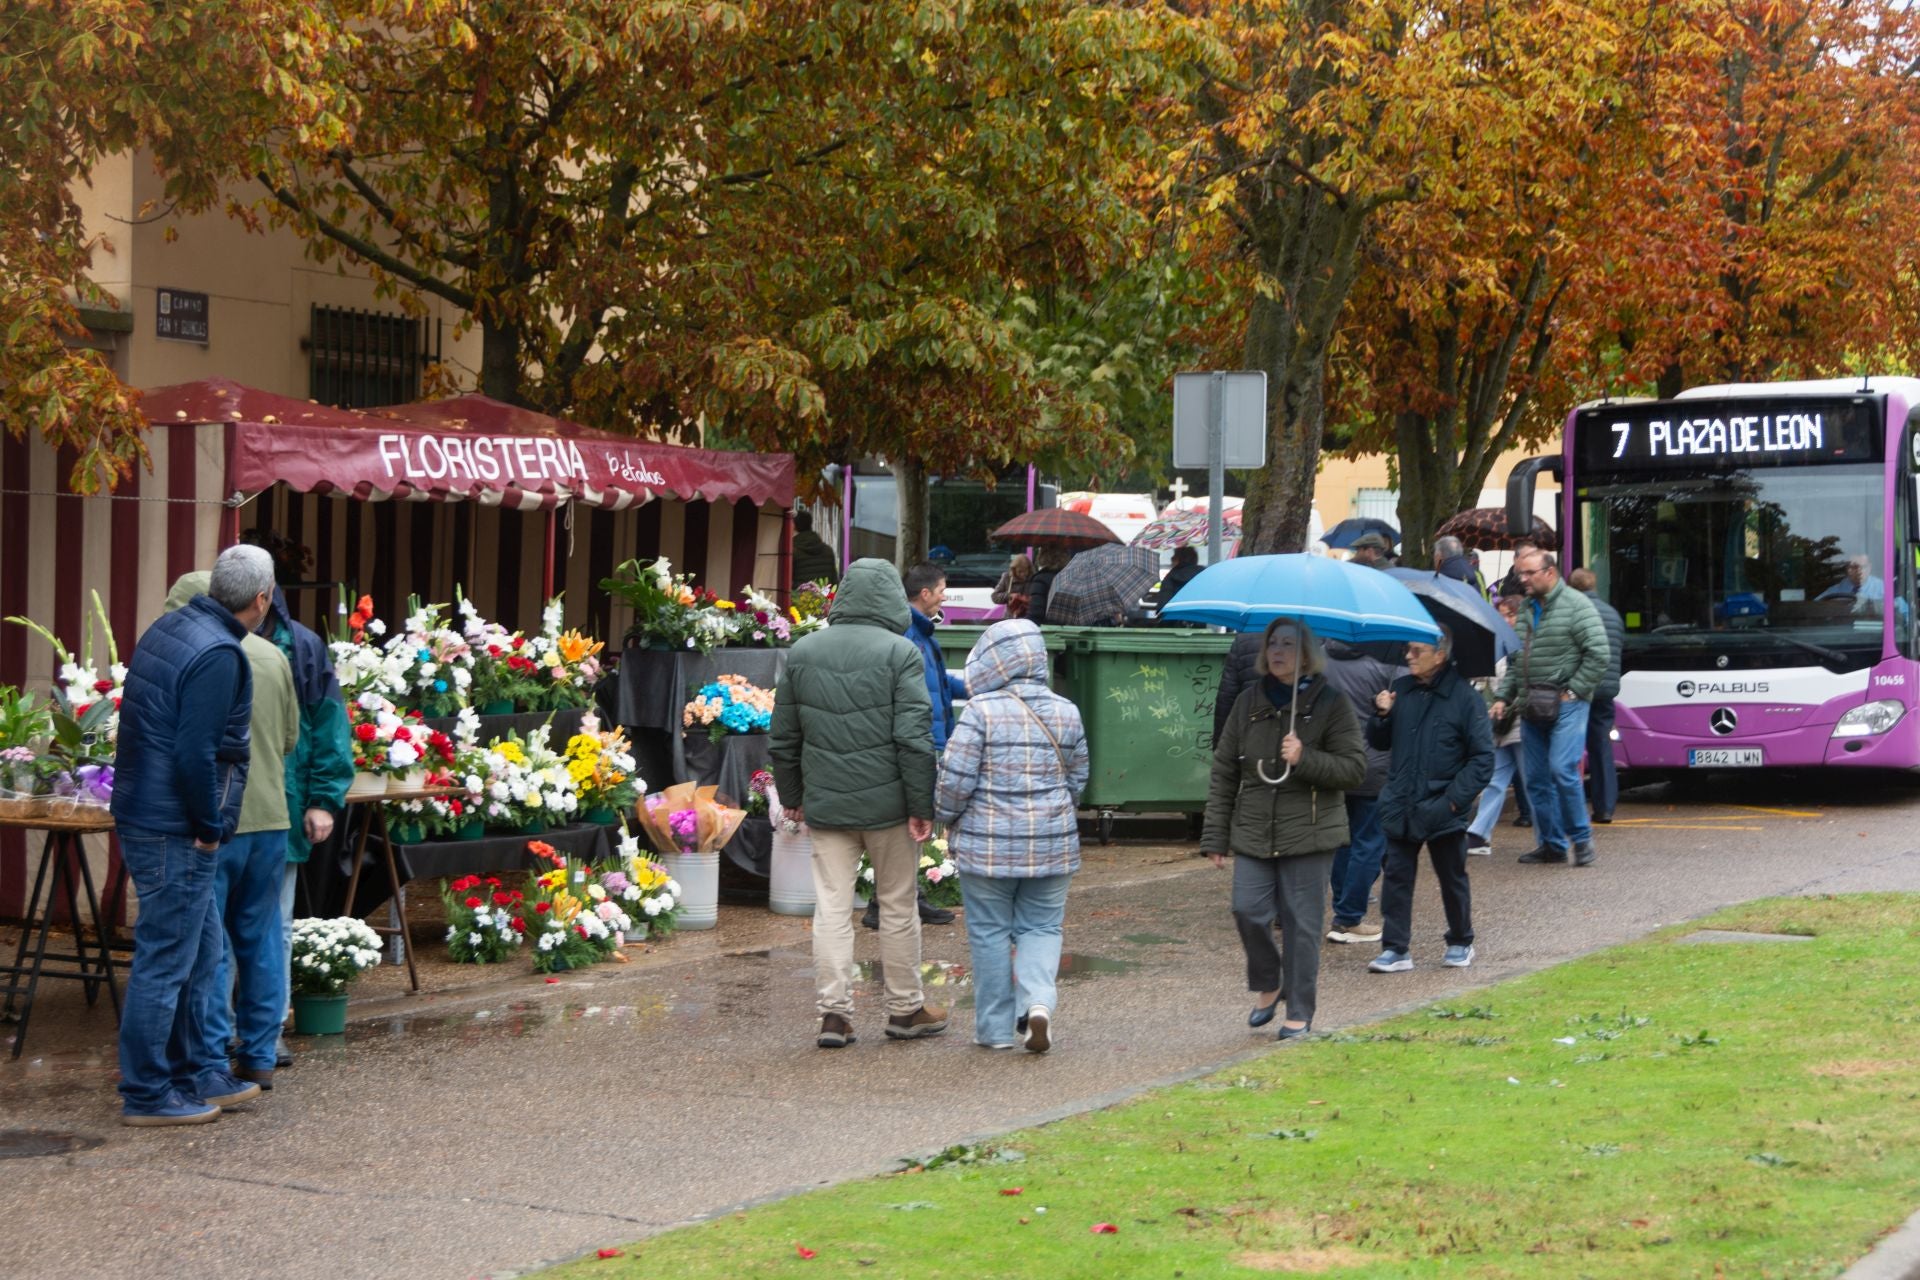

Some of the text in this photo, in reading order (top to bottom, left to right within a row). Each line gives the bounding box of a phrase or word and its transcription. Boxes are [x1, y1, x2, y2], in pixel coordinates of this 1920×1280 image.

[1611, 413, 1823, 458] 7 PLAZA DE LEON
[378, 434, 590, 480] FLORISTERIA
[1873, 675, 1904, 686] 10456
[1698, 682, 1769, 693] PALBUS
[1696, 752, 1759, 763] 8842 LMN
